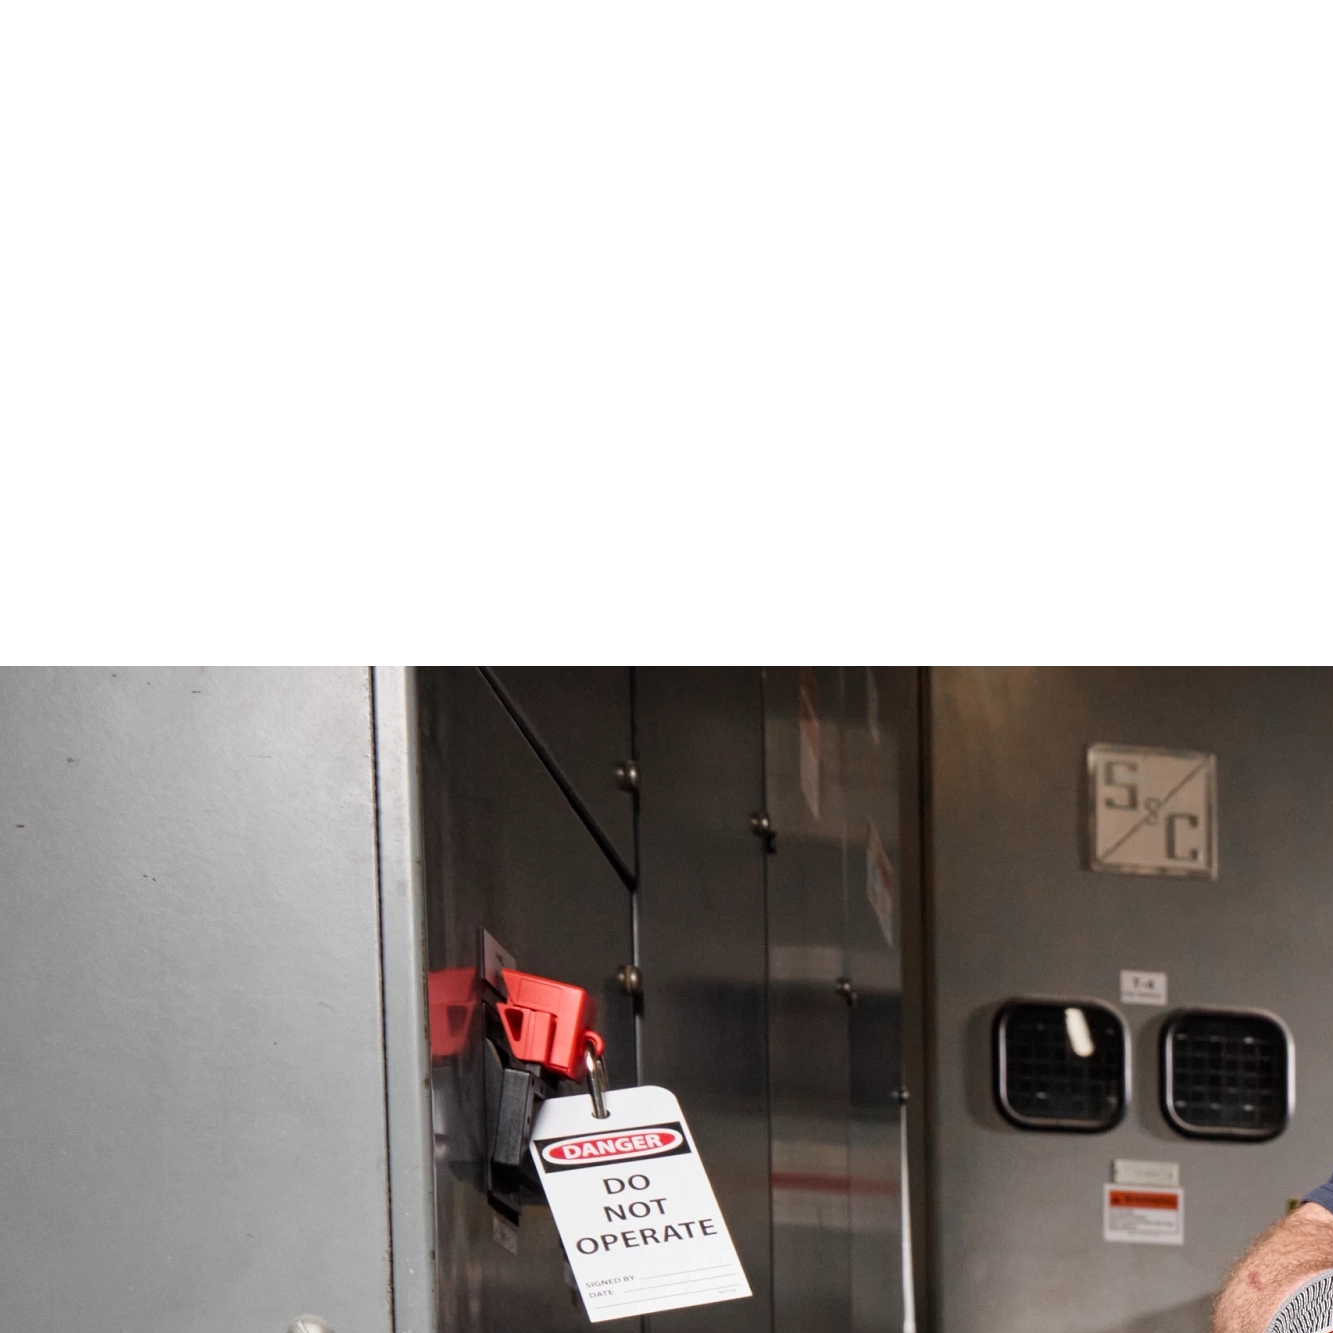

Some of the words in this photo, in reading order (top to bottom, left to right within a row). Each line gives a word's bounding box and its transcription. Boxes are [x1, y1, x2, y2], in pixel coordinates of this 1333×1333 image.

[562, 1133, 663, 1160] DANGER
[603, 1174, 650, 1195] DO
[603, 1198, 667, 1222] NOT
[576, 1218, 718, 1255] OPERATE
[585, 1277, 621, 1289] SIGNED
[623, 1275, 636, 1283] BY
[589, 1289, 614, 1299] DATE
